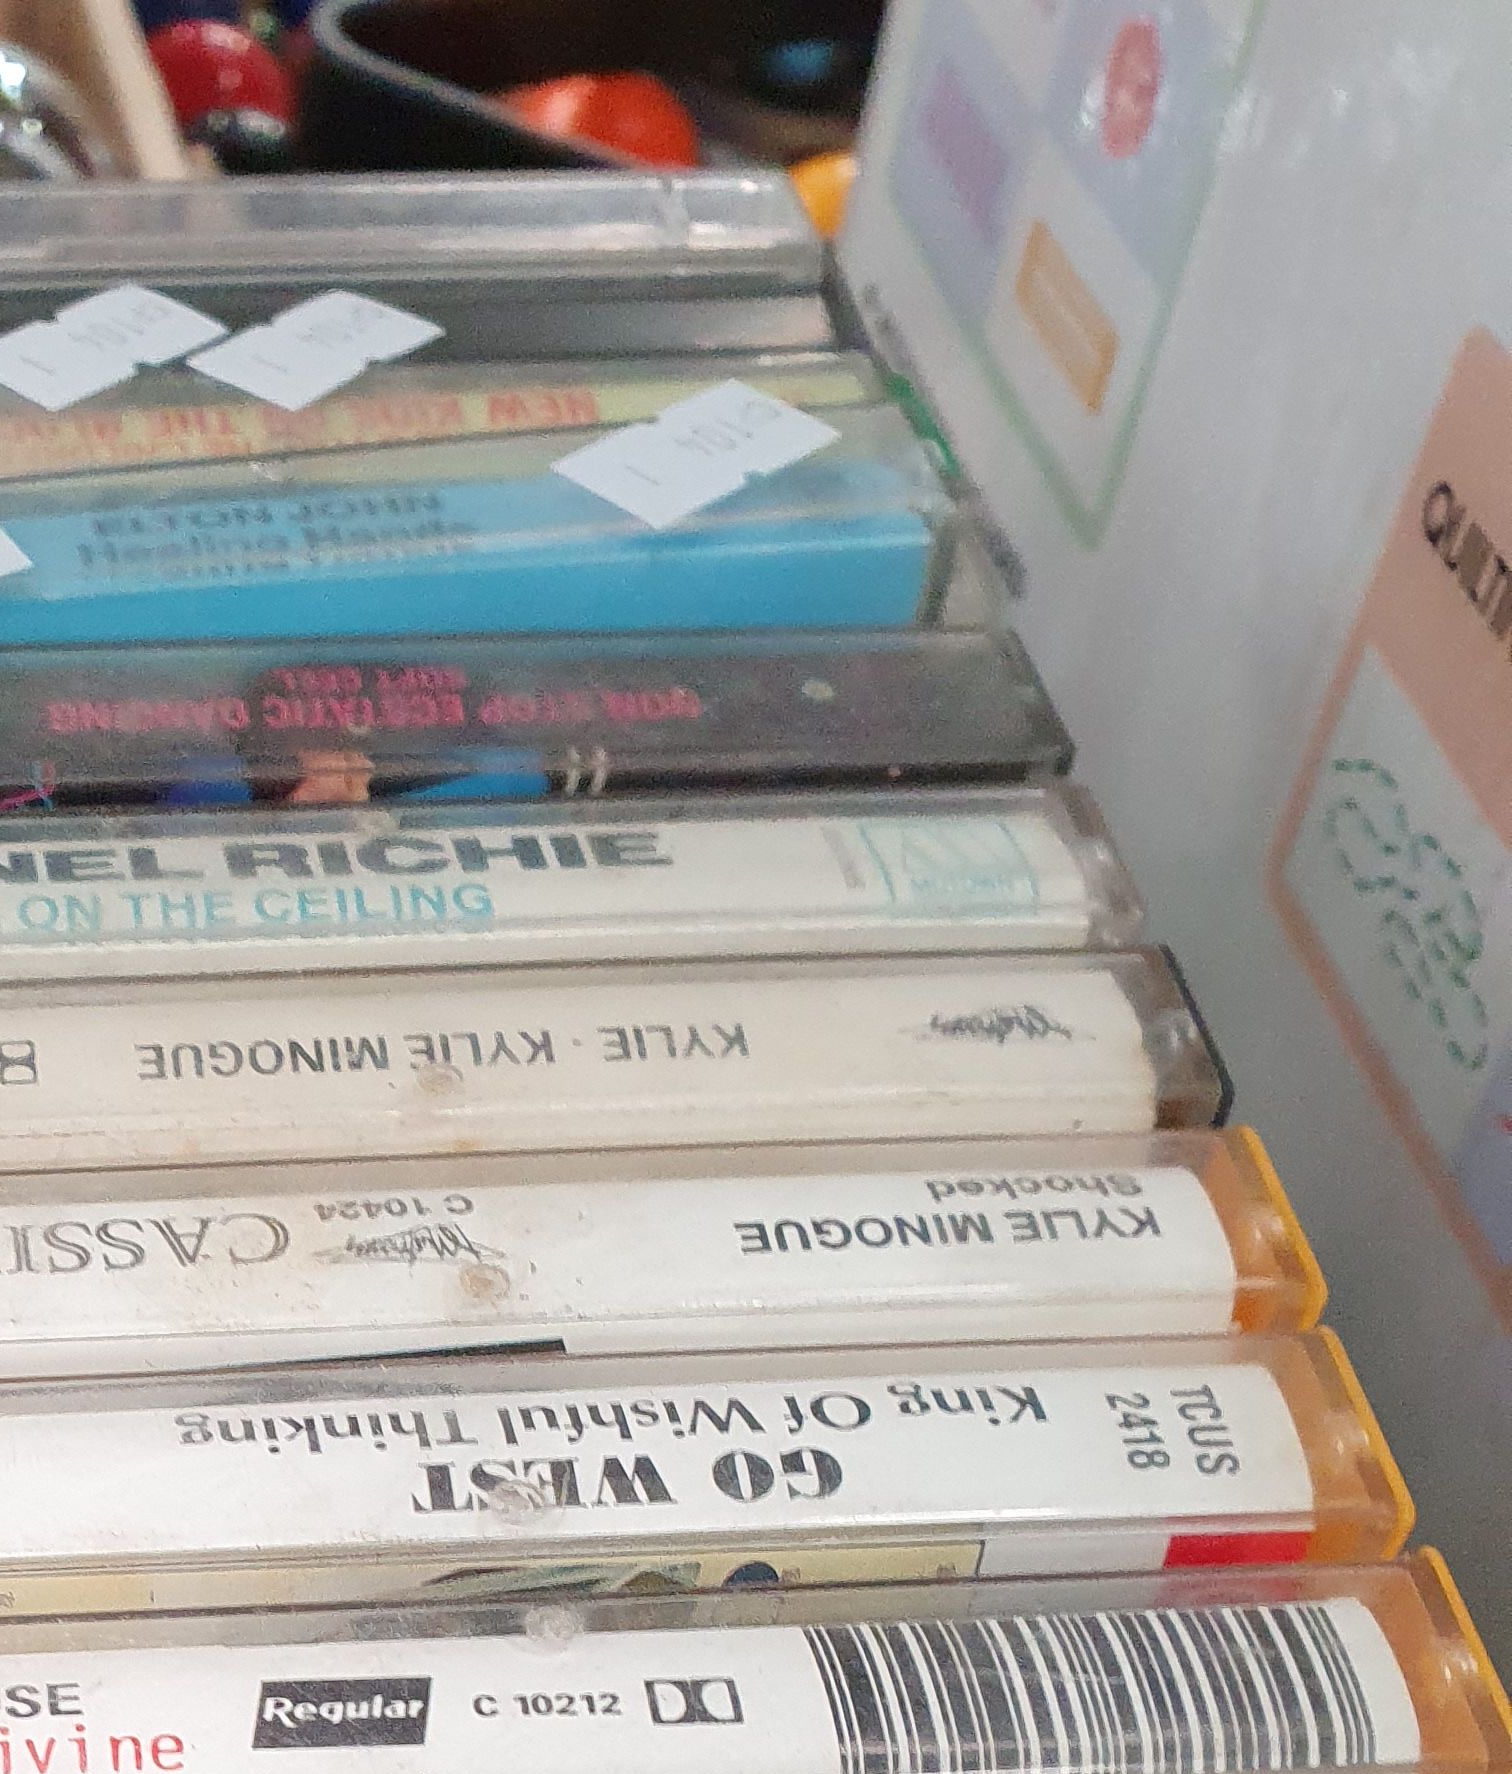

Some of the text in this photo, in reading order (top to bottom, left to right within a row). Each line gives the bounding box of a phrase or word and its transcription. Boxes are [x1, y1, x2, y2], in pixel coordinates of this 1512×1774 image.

[223, 832, 674, 879] RICHIE
[17, 892, 101, 933] ON
[122, 889, 235, 930] THE
[255, 881, 496, 925] CEILING
[135, 1022, 751, 1080] KYLIE KYLIE MINOGUE
[443, 1194, 474, 1216] C
[927, 1177, 1143, 1200] Shocked
[734, 1207, 1162, 1256] KYLIE MINOGUE
[173, 1382, 1049, 1455] King Of Wishful Thinking
[1104, 1392, 1170, 1469] 2418
[410, 1447, 844, 1514] GO WEST
[262, 1692, 426, 1730] Regular
[472, 1690, 623, 1718] C 10212
